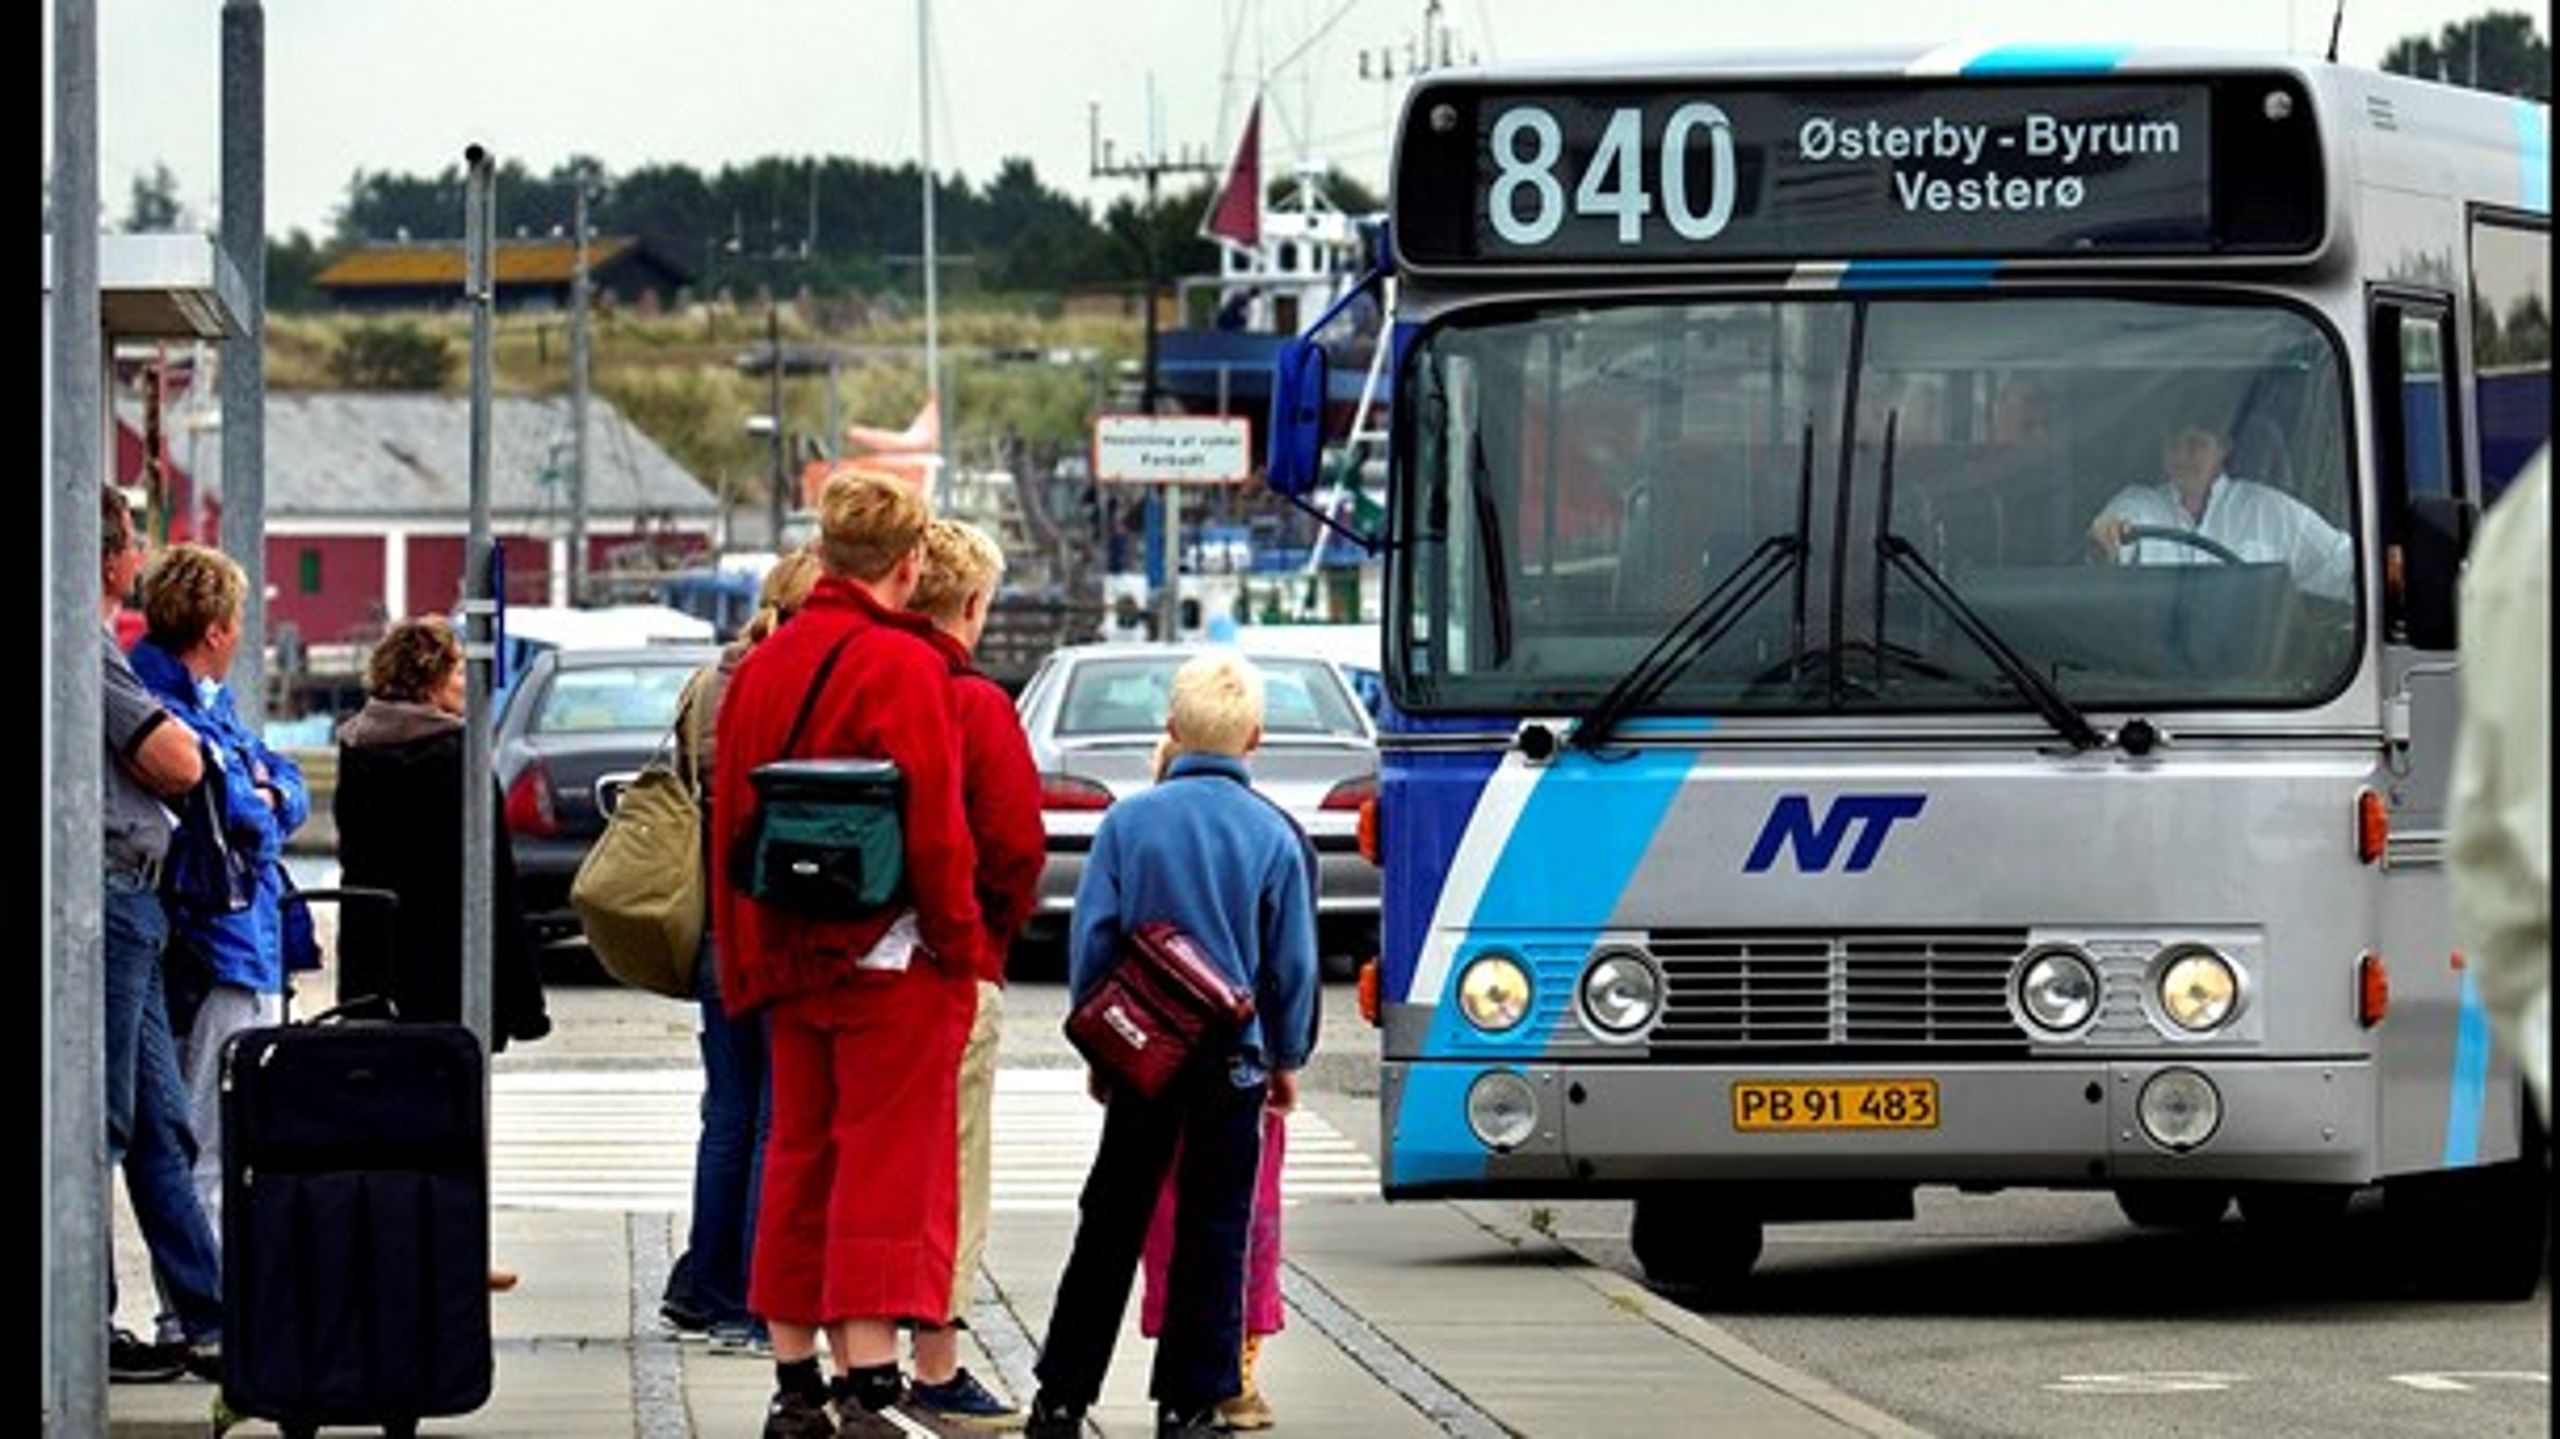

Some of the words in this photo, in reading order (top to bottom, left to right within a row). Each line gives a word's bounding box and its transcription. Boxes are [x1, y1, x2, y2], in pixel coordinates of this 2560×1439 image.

[1800, 117, 1987, 164] Østerby
[2026, 115, 2179, 163] Byrum
[1488, 102, 1736, 244] 840
[1896, 171, 2085, 210] Vesterø
[1742, 794, 1927, 873] NT
[1741, 1089, 1794, 1121] PB
[1803, 1089, 1842, 1121] 91
[1859, 1089, 1931, 1121] 483
